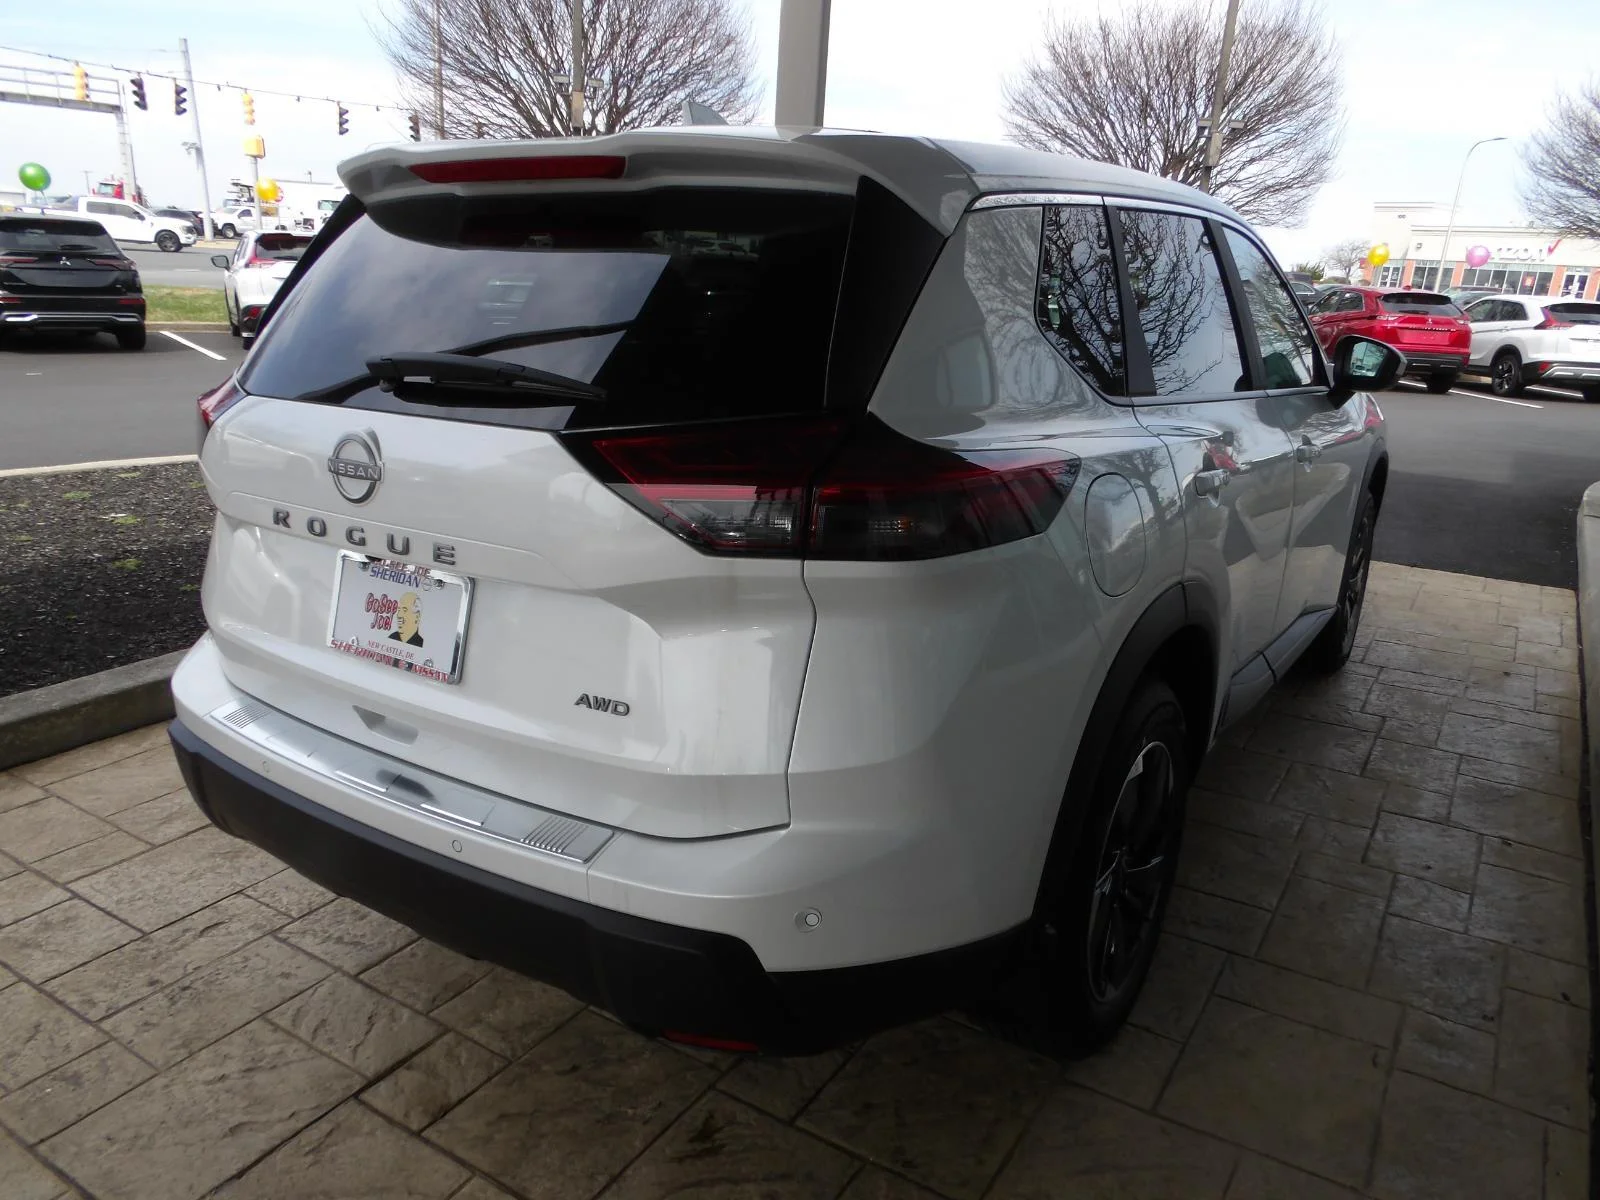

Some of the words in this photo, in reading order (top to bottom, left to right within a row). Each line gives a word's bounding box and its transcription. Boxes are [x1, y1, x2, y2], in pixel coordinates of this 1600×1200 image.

[328, 460, 380, 480] NISSAN
[272, 507, 457, 565] ROGUE
[370, 566, 421, 588] SHERIDAN
[367, 640, 380, 649] NEW
[405, 651, 415, 659] DE
[574, 693, 630, 716] AWD
